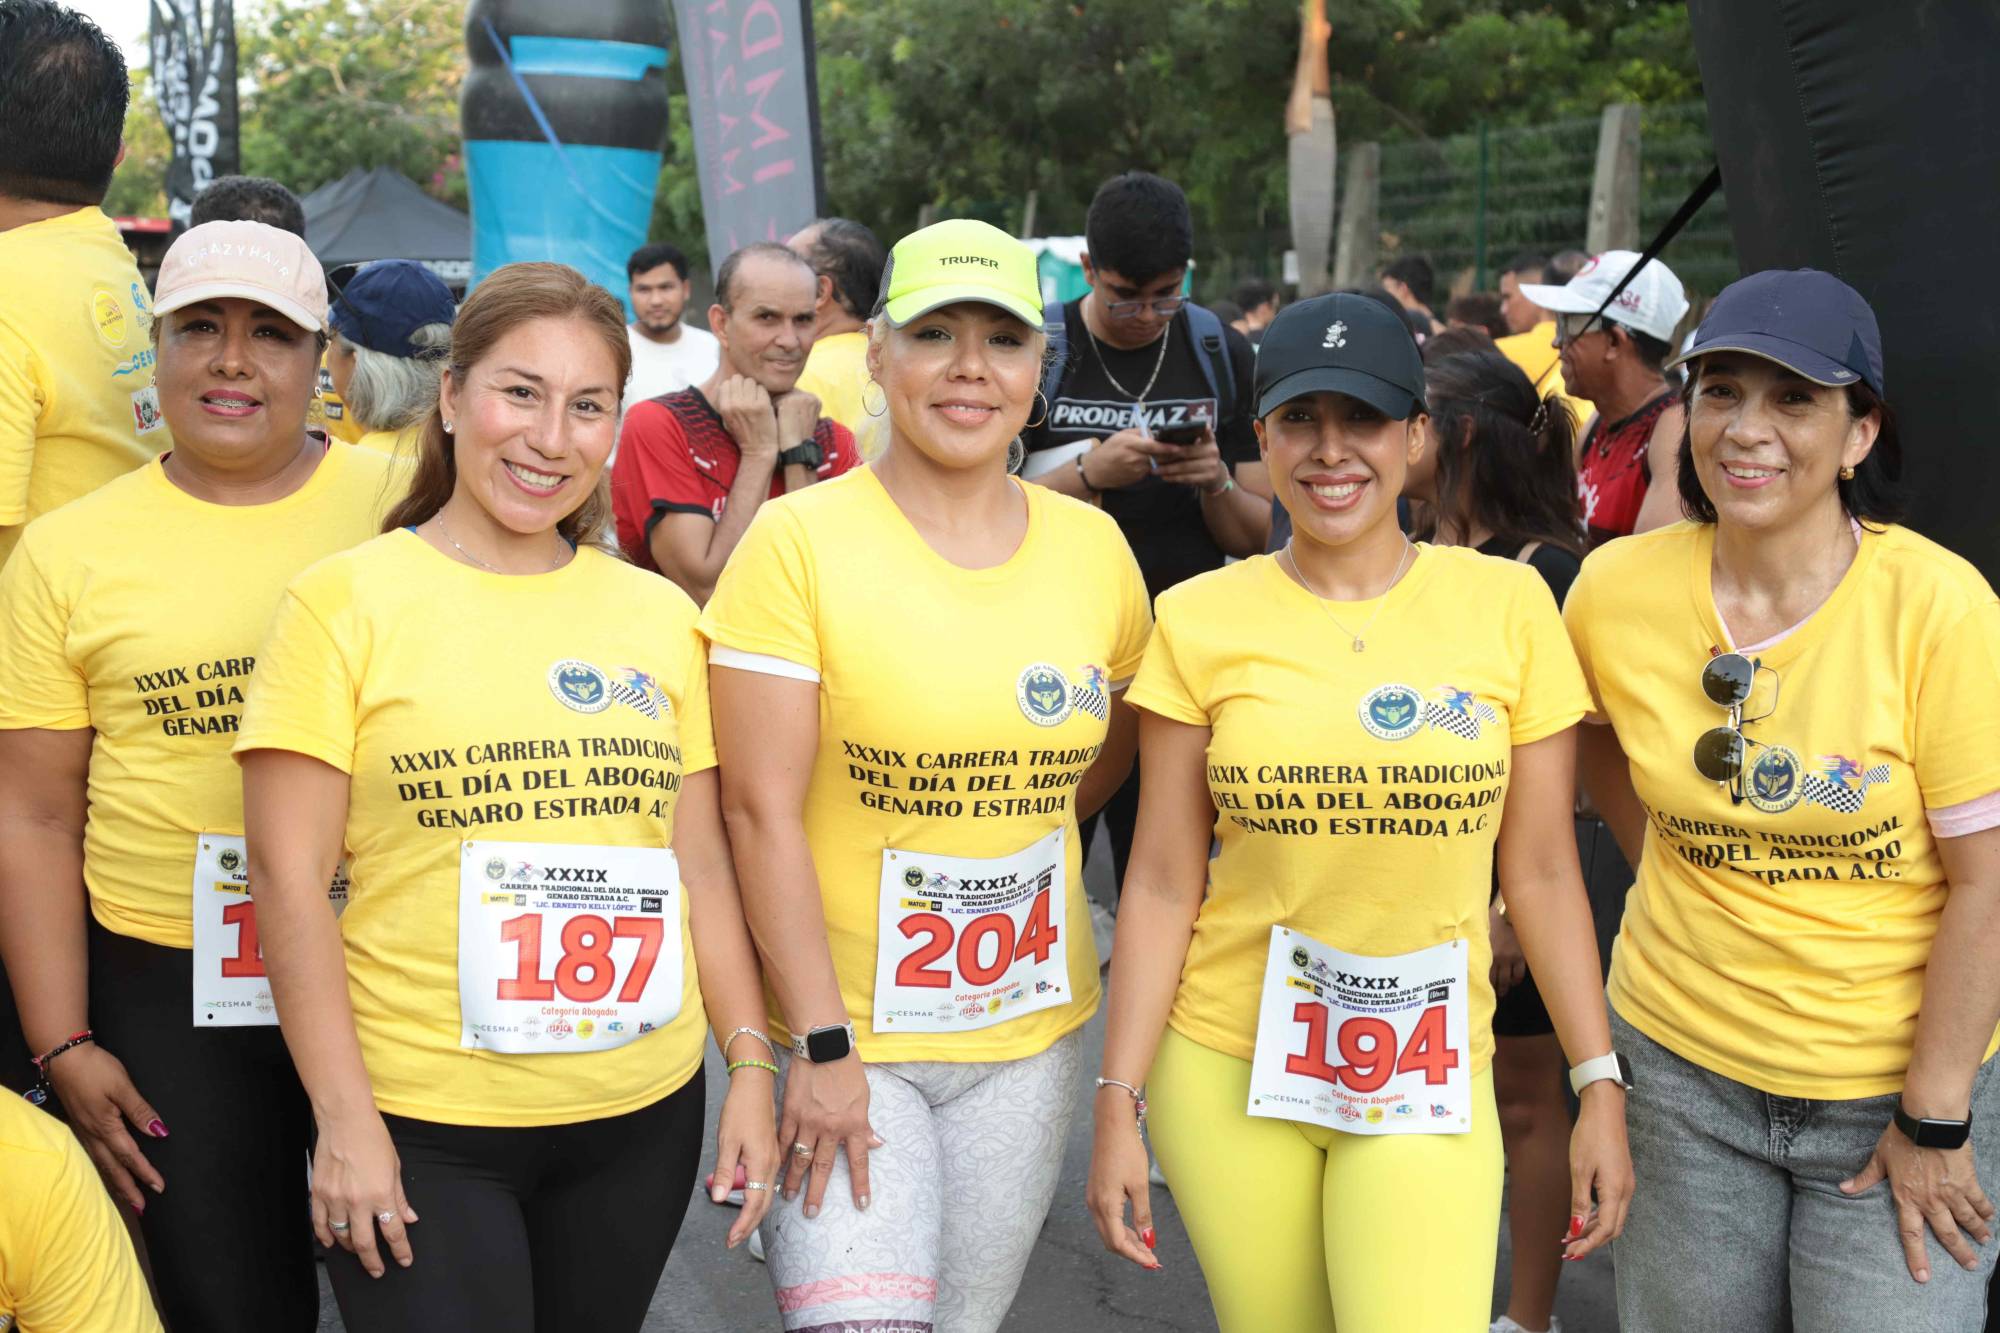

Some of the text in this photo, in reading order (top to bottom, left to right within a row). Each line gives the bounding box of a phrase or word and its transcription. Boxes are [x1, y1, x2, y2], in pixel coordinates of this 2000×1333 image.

[939, 255, 999, 270] TRUPER
[133, 666, 190, 694] XXXIX
[143, 683, 245, 715] DEL DÍA
[162, 714, 242, 736] GENAR
[390, 749, 456, 774] XXXIX
[466, 739, 571, 765] CARRERA
[842, 740, 906, 768] XXXIX
[916, 750, 1018, 770] CARRERA
[849, 764, 898, 789] DEL
[909, 772, 956, 792] DÍA
[967, 774, 1018, 792] DEL
[1257, 765, 1369, 784] CARRERA
[1377, 759, 1507, 784] TRADICIONAL
[399, 766, 680, 801] DEL DÍA DEL ABOGADO
[860, 791, 1065, 817] GENARO ESTRADA
[1213, 786, 1501, 810] DEL DÍA DEL ABOGADO
[417, 802, 523, 828] GENARO
[534, 796, 640, 819] ESTRADA
[1329, 818, 1448, 837] ESTRADA
[1456, 813, 1488, 836] A.C.
[1657, 811, 1752, 839] CARRERA
[1756, 816, 1904, 848] TRADICIONAL
[1706, 840, 1902, 861] DEL ABOGADO
[544, 867, 608, 883] XXXIX
[959, 872, 1018, 891] XXXIX
[1849, 861, 1900, 880] A.C.
[500, 883, 538, 891] CARRERA
[540, 884, 592, 893] TRADICIONAL
[546, 893, 579, 901] GENARO
[917, 890, 953, 899] CARRERA
[955, 892, 1004, 900] TRADICIONAL
[1005, 888, 1017, 897] DEL
[552, 902, 587, 910] ERNESTO
[966, 905, 1000, 914] ERNESTO
[999, 899, 1019, 910] KELLY
[895, 888, 1058, 988] 204
[497, 913, 664, 1003] 187
[1303, 971, 1332, 988] CARRERA
[1332, 984, 1383, 999] TRADICIONAL
[1411, 986, 1424, 994] DEL
[1424, 977, 1456, 990] ABOGADO
[1335, 970, 1399, 990] XXXIX
[1337, 993, 1369, 1005] GENARO
[1370, 998, 1405, 1006] ESTRADA
[1341, 1001, 1378, 1014] ERNESTO
[1378, 1005, 1402, 1014] KELLY
[581, 1008, 618, 1017] Abogados
[1285, 1000, 1459, 1094] 194
[1273, 1094, 1311, 1105] CESMAR
[1370, 1093, 1405, 1105] Abogados
